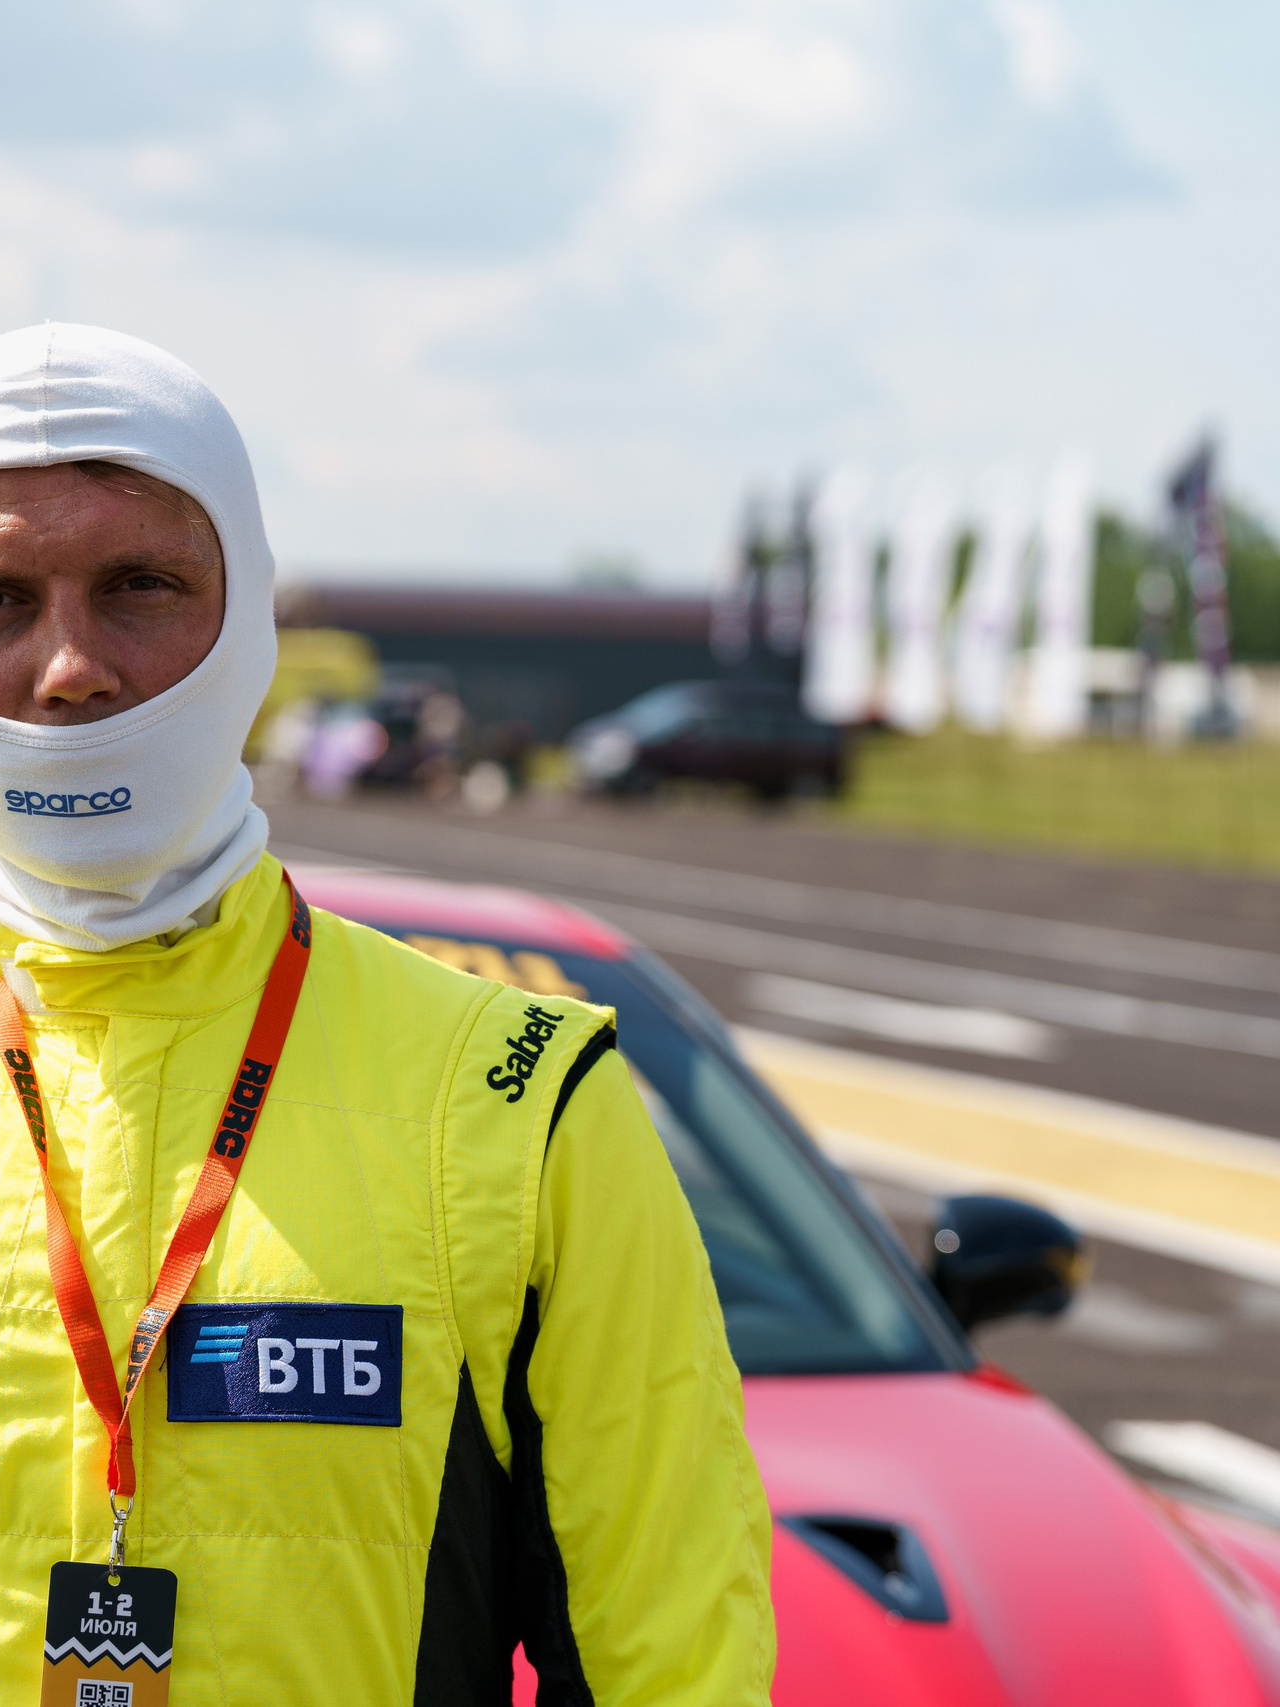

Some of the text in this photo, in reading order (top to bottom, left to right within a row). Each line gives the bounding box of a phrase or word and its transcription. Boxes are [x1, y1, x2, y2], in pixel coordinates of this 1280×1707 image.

[4, 786, 131, 817] sparco
[486, 1003, 564, 1103] Sabelt
[213, 1058, 273, 1159] RDRC
[257, 1338, 381, 1396] ВТБ
[87, 1591, 133, 1617] 1-2
[80, 1617, 137, 1637] ИЮЛЯ
